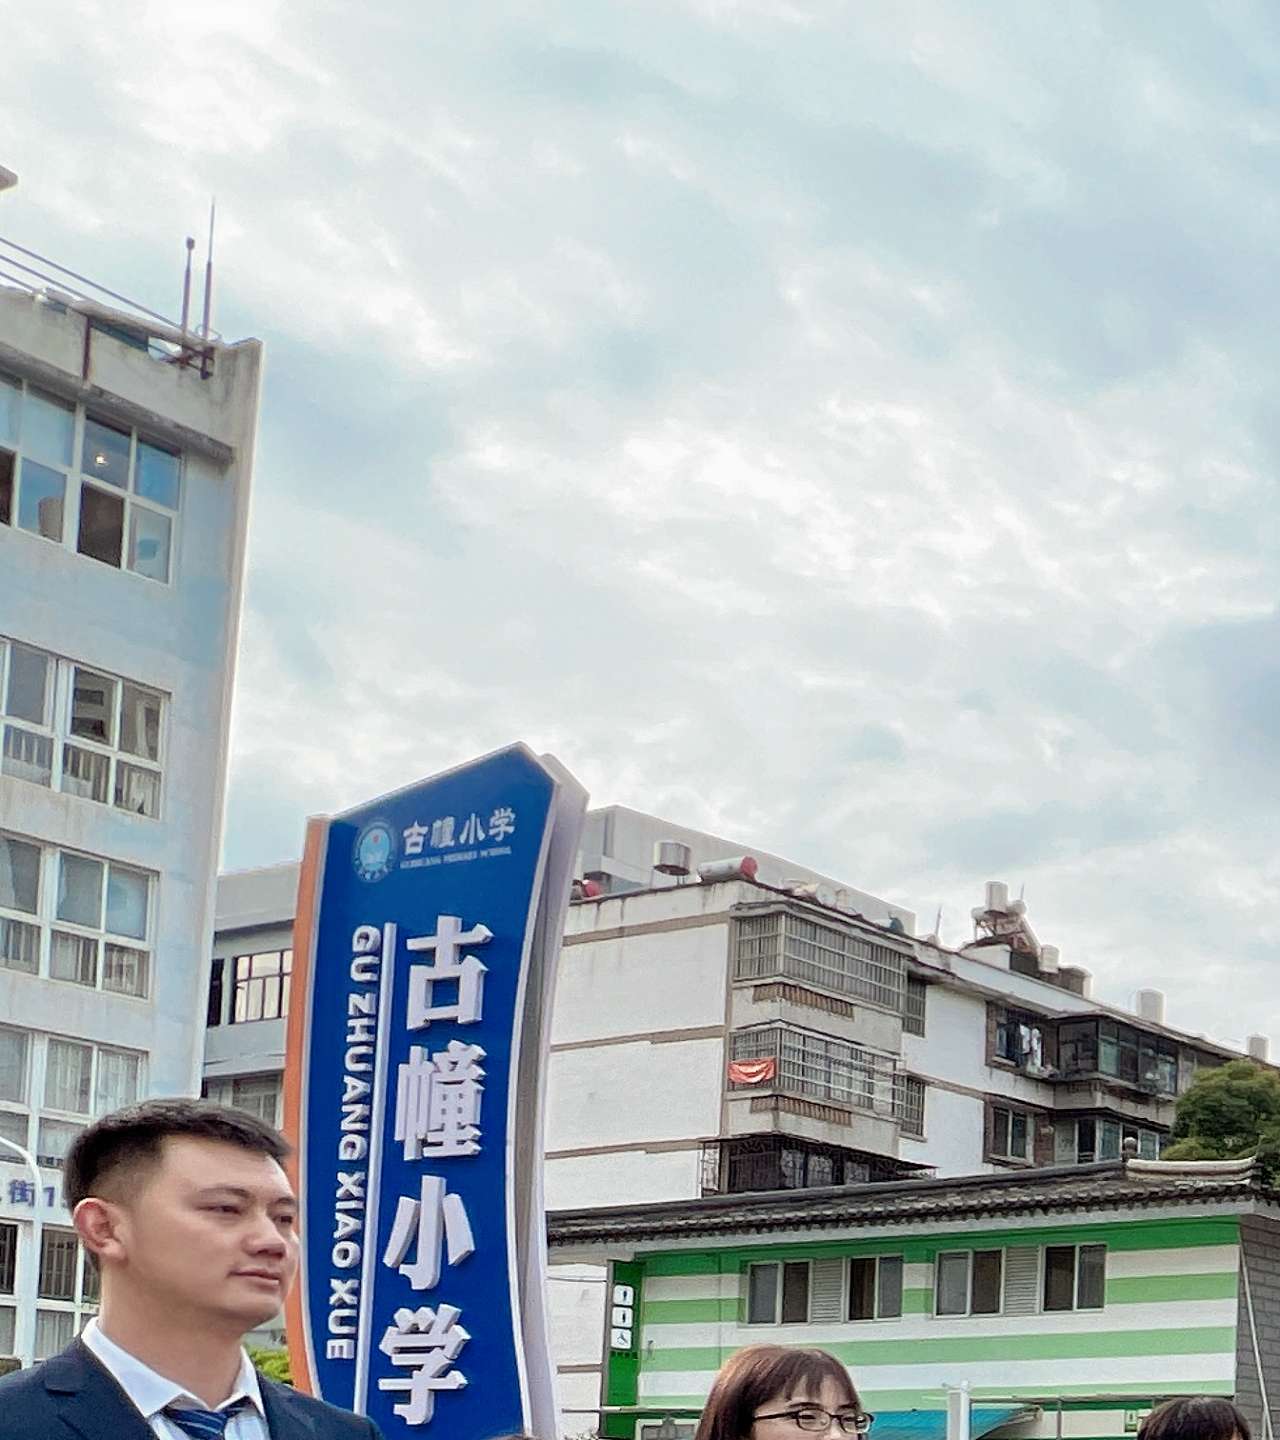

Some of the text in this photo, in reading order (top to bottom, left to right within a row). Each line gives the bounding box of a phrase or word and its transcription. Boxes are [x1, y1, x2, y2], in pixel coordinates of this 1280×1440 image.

[326, 925, 381, 1359] GU ZHUANG XIAO XUE
